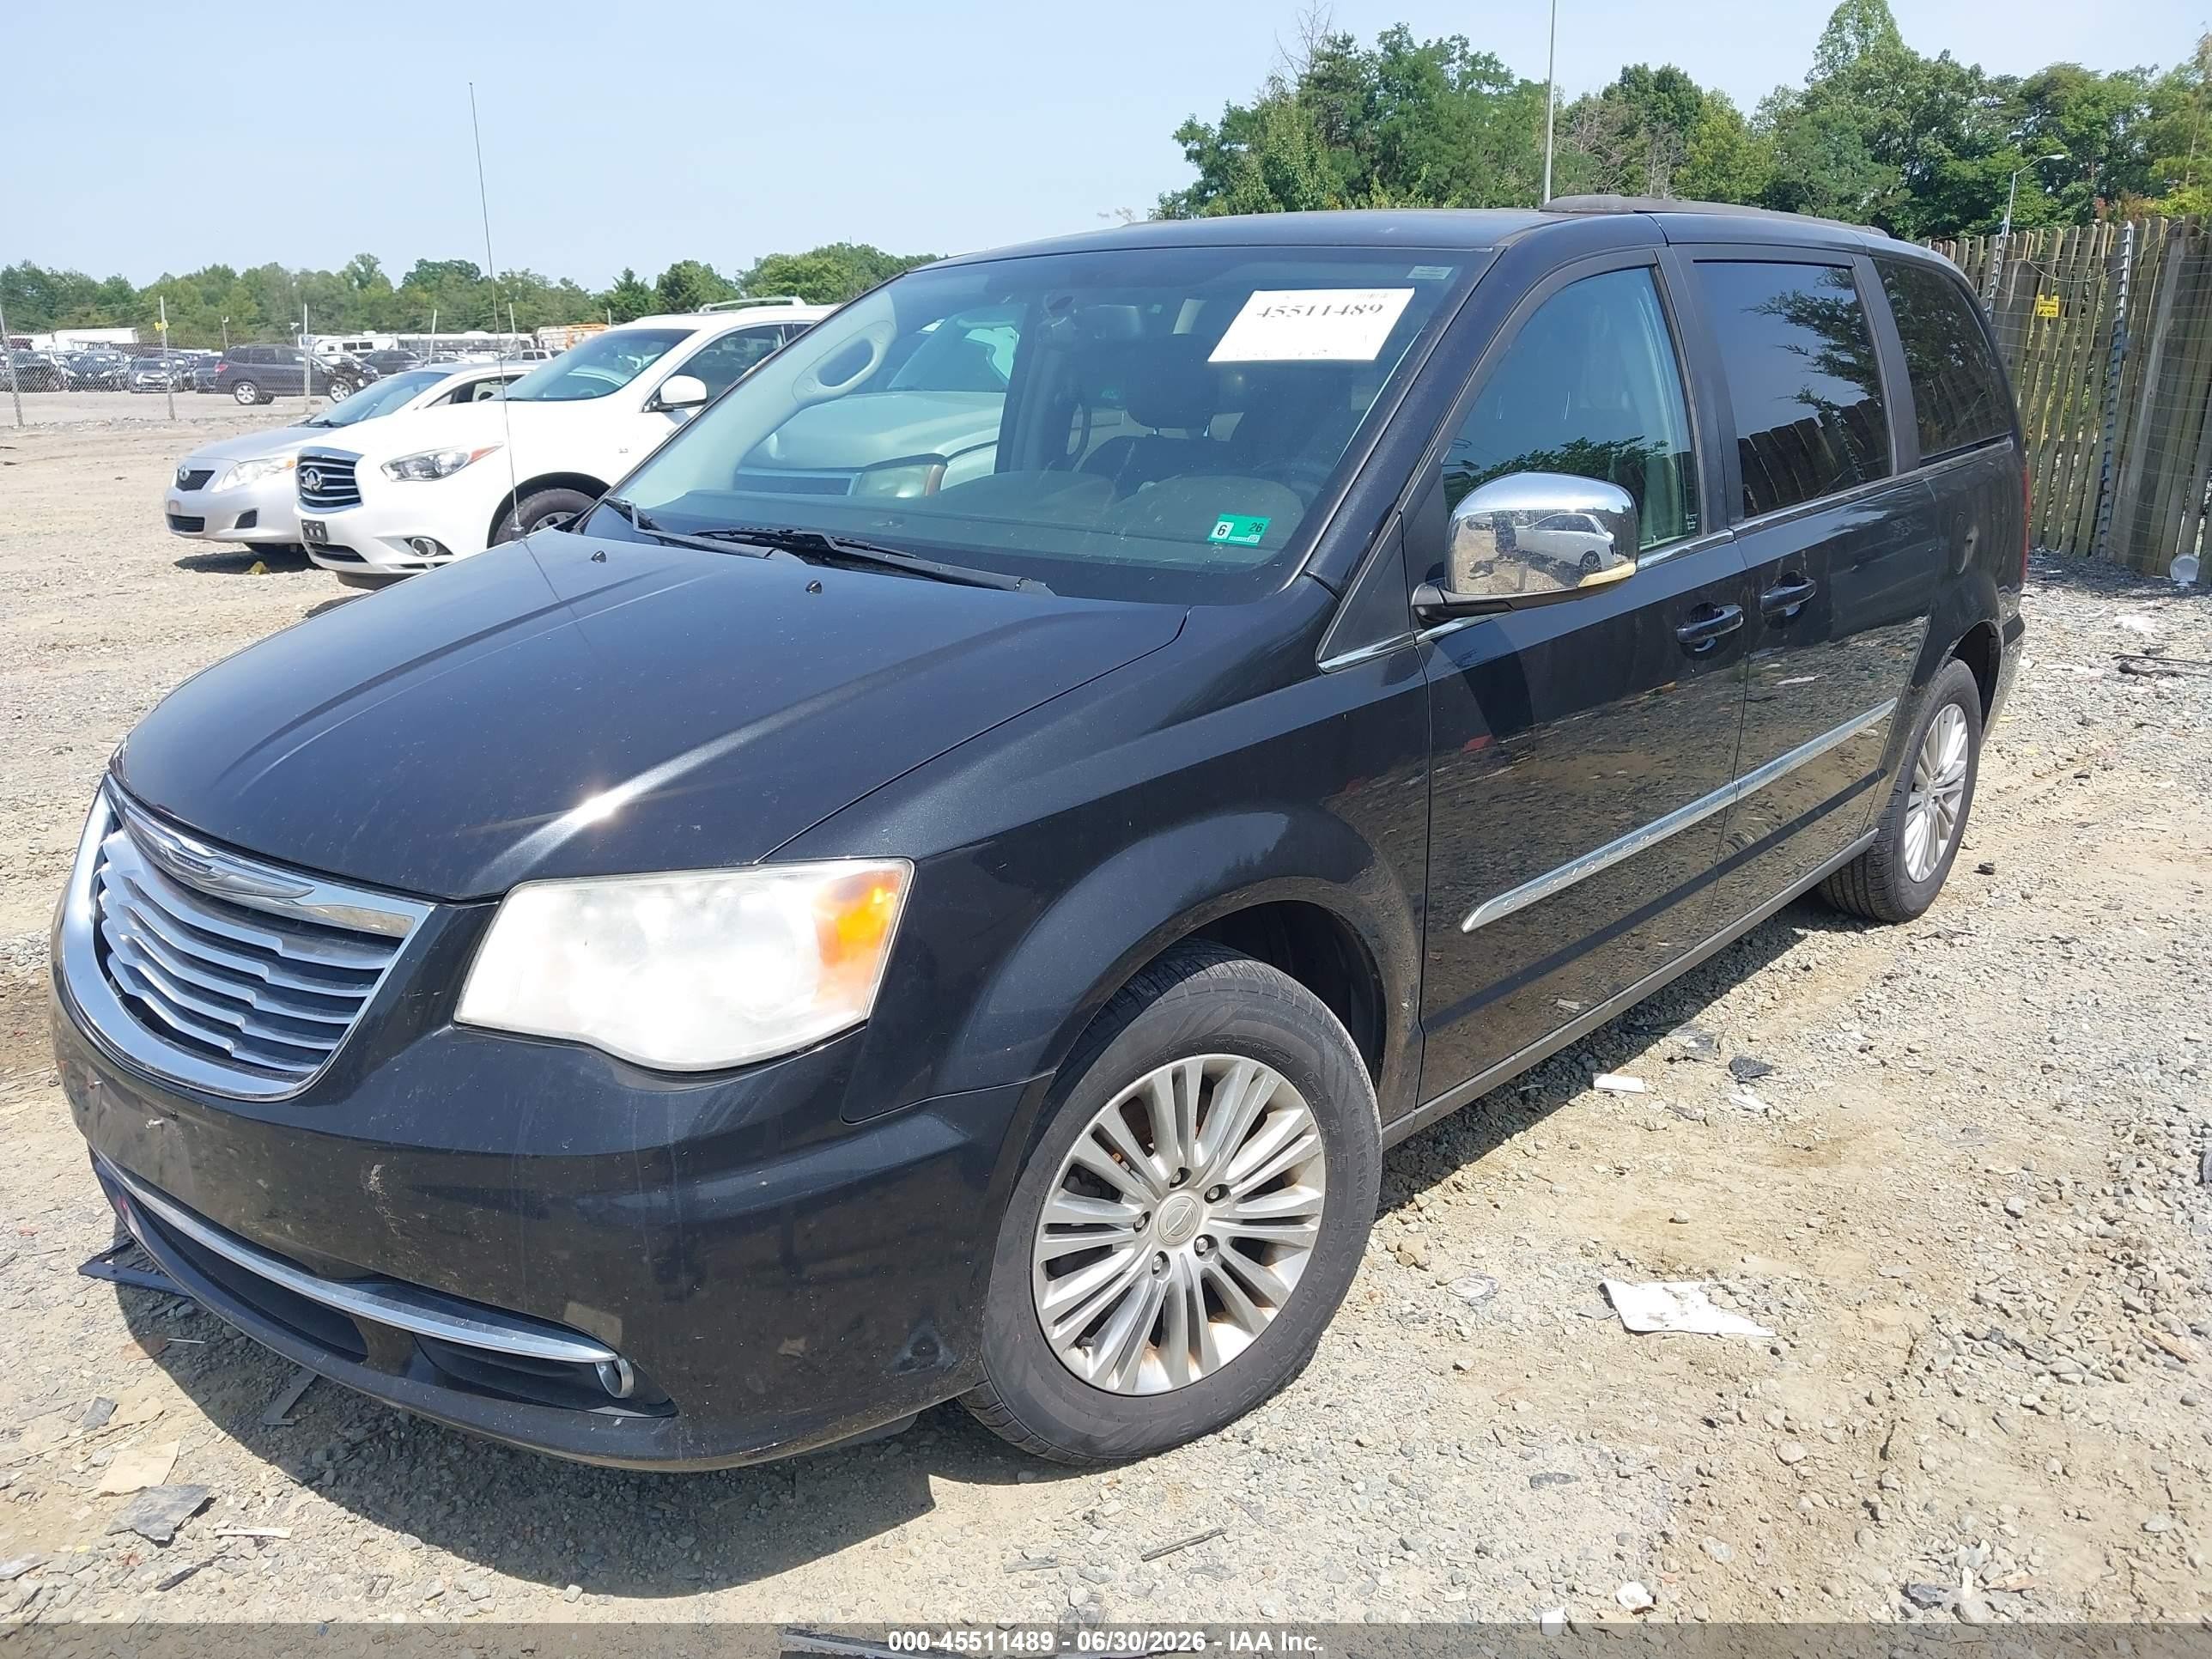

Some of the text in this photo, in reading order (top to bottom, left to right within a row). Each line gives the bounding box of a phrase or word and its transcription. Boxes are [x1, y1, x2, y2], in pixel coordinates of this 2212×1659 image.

[1256, 303, 1383, 318] 45511489
[1217, 524, 1228, 536] 6
[1249, 522, 1264, 532] 26
[1504, 835, 1650, 911] CHRYSLER
